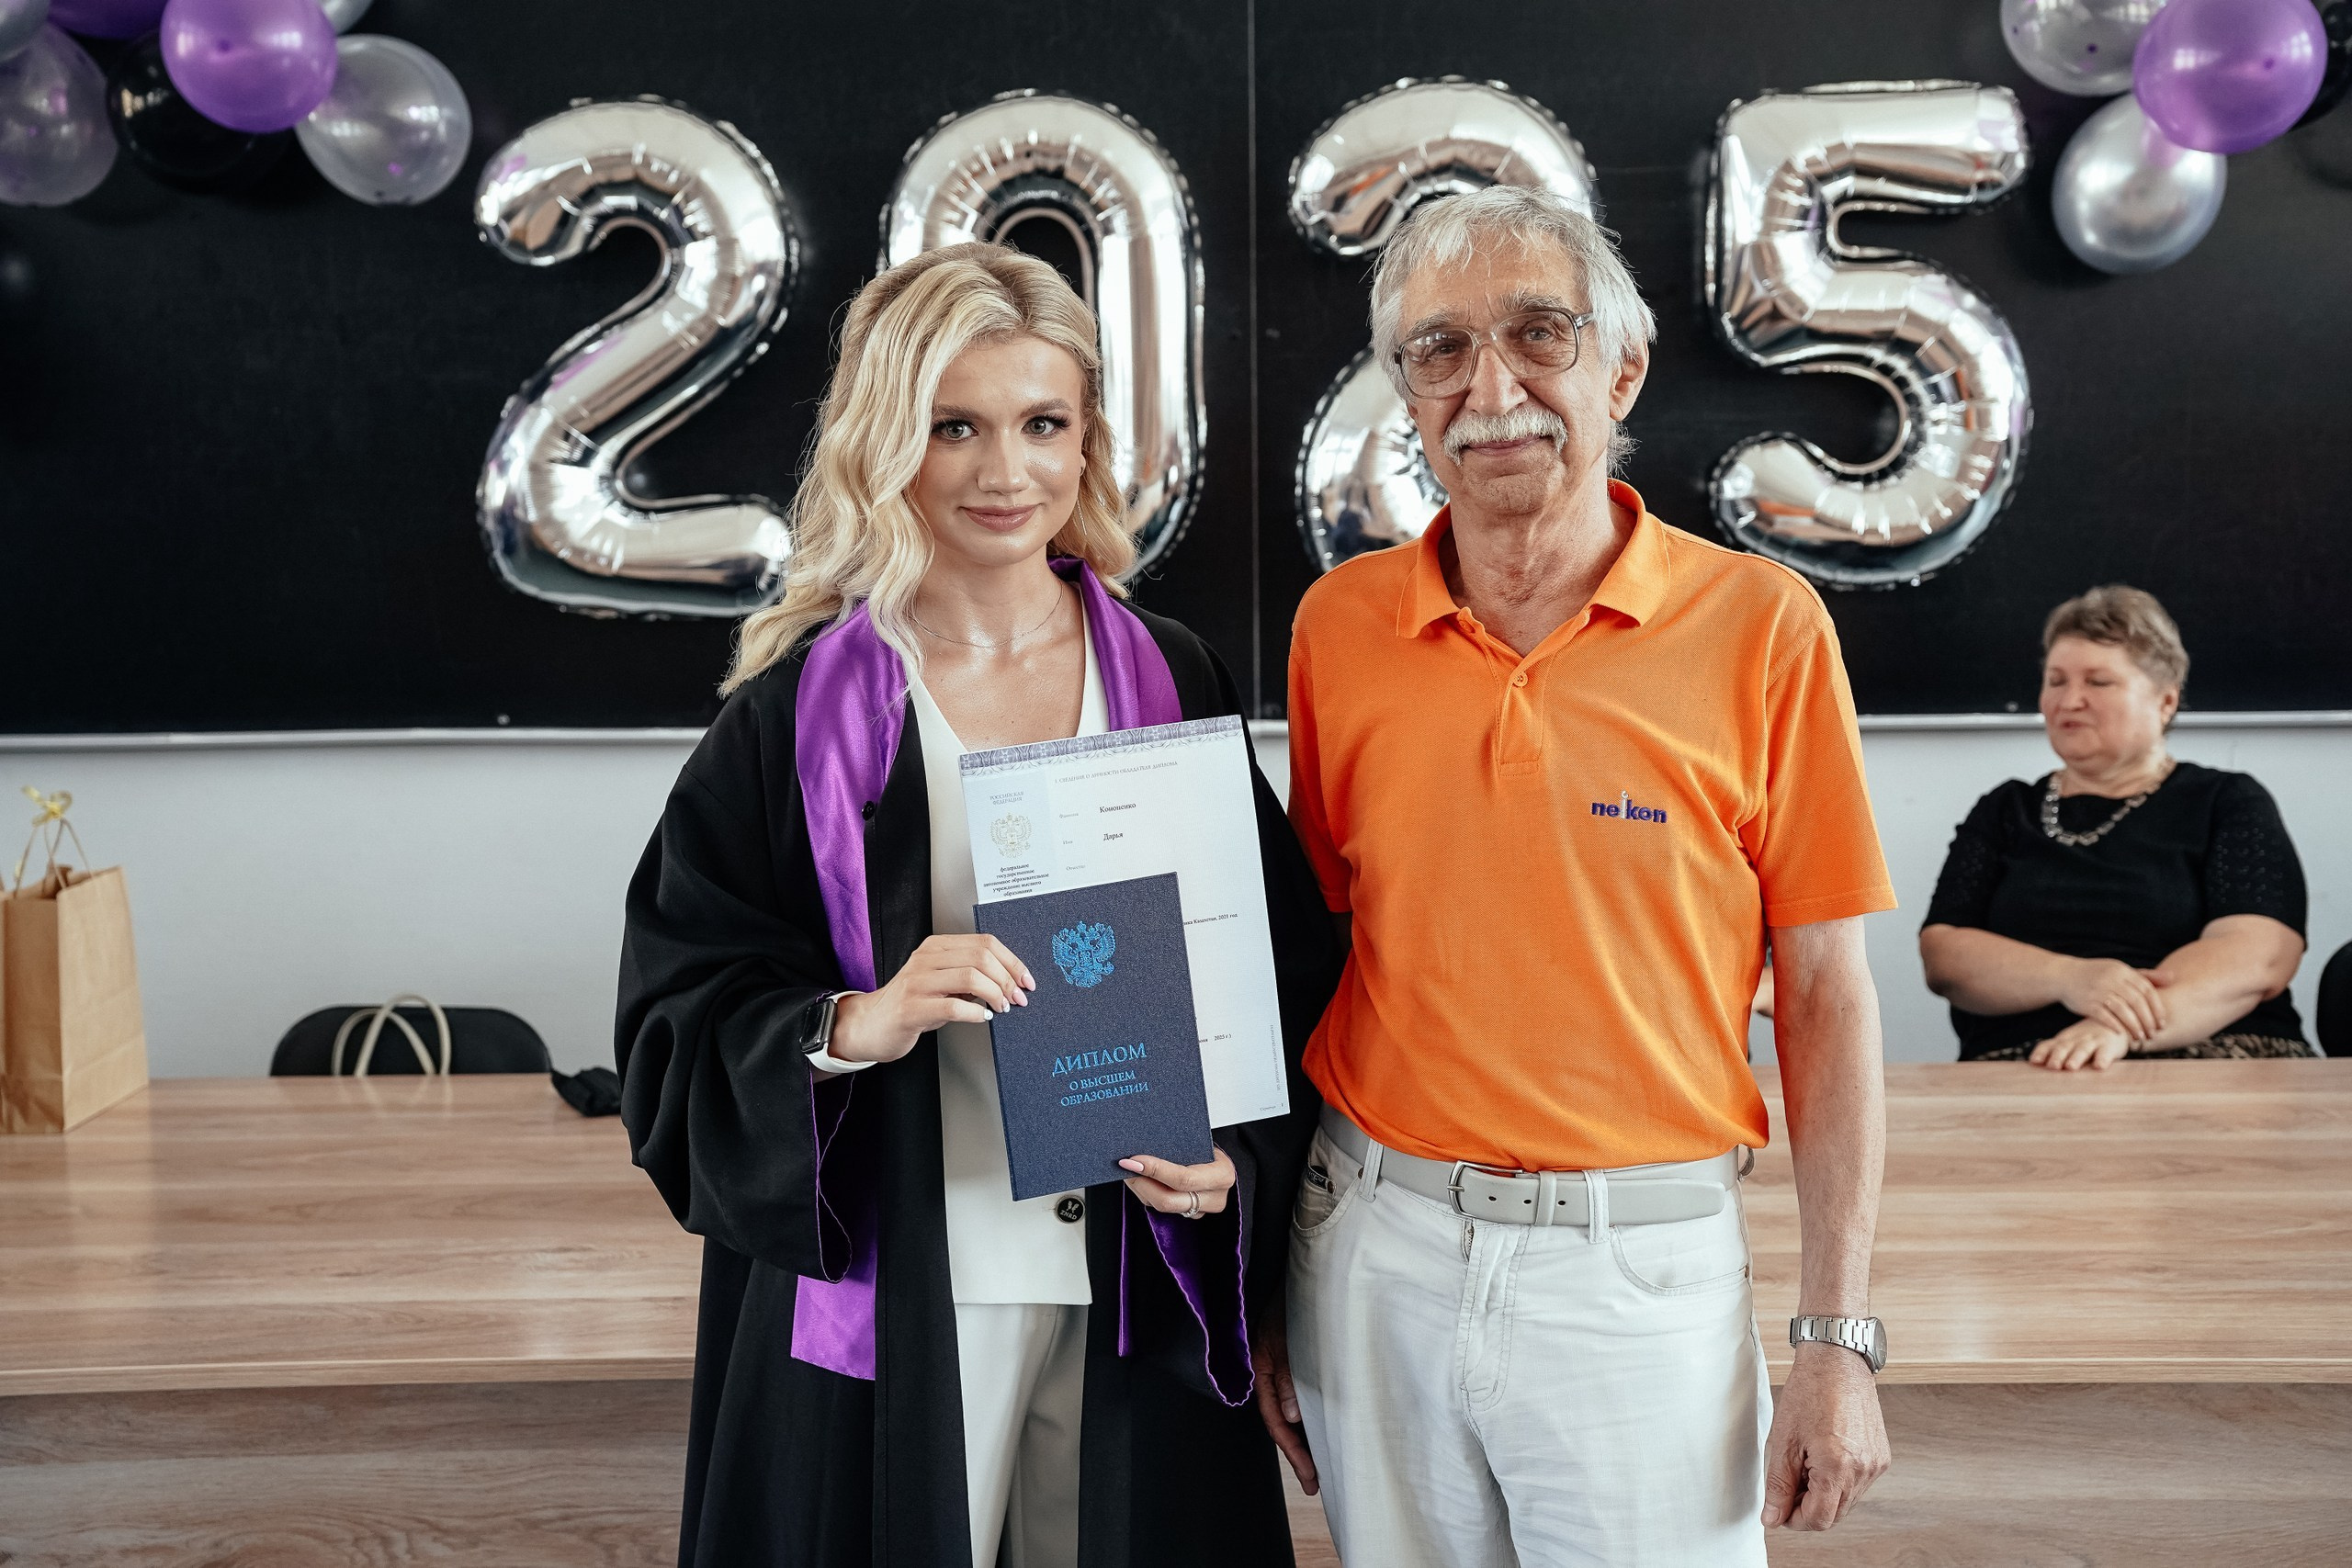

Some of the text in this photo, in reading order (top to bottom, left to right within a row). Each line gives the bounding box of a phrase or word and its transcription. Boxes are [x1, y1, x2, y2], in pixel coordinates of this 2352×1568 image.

[1102, 831, 1124, 841] Дарья
[1052, 1043, 1148, 1077] ДИПЛОМ
[1069, 1070, 1136, 1091] О ВЫСШЕМ
[1060, 1082, 1149, 1107] ОБРАЗОВАНИИ
